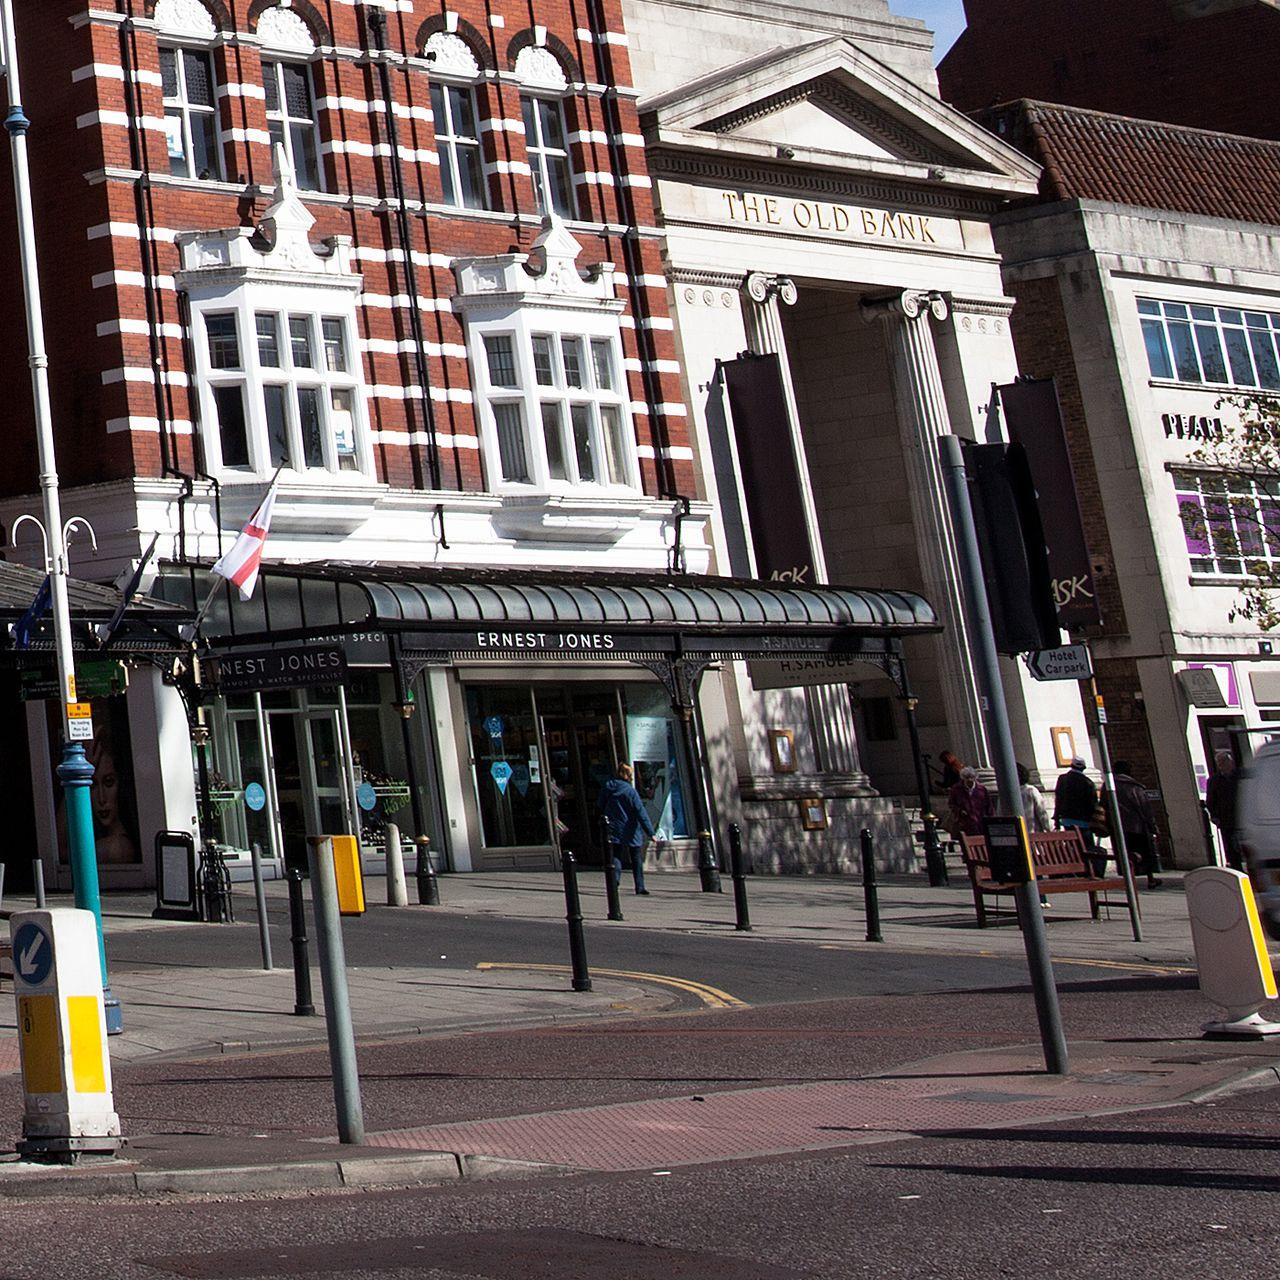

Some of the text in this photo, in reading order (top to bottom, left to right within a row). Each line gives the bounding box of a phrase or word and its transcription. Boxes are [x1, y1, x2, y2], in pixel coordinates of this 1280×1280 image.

[722, 192, 935, 243] THE OLD BANK
[352, 633, 386, 642] SPECI
[477, 632, 614, 649] ERNEST JONES
[1049, 650, 1077, 661] Hotel
[221, 652, 341, 675] NEST JONES
[1045, 663, 1086, 675] Car park
